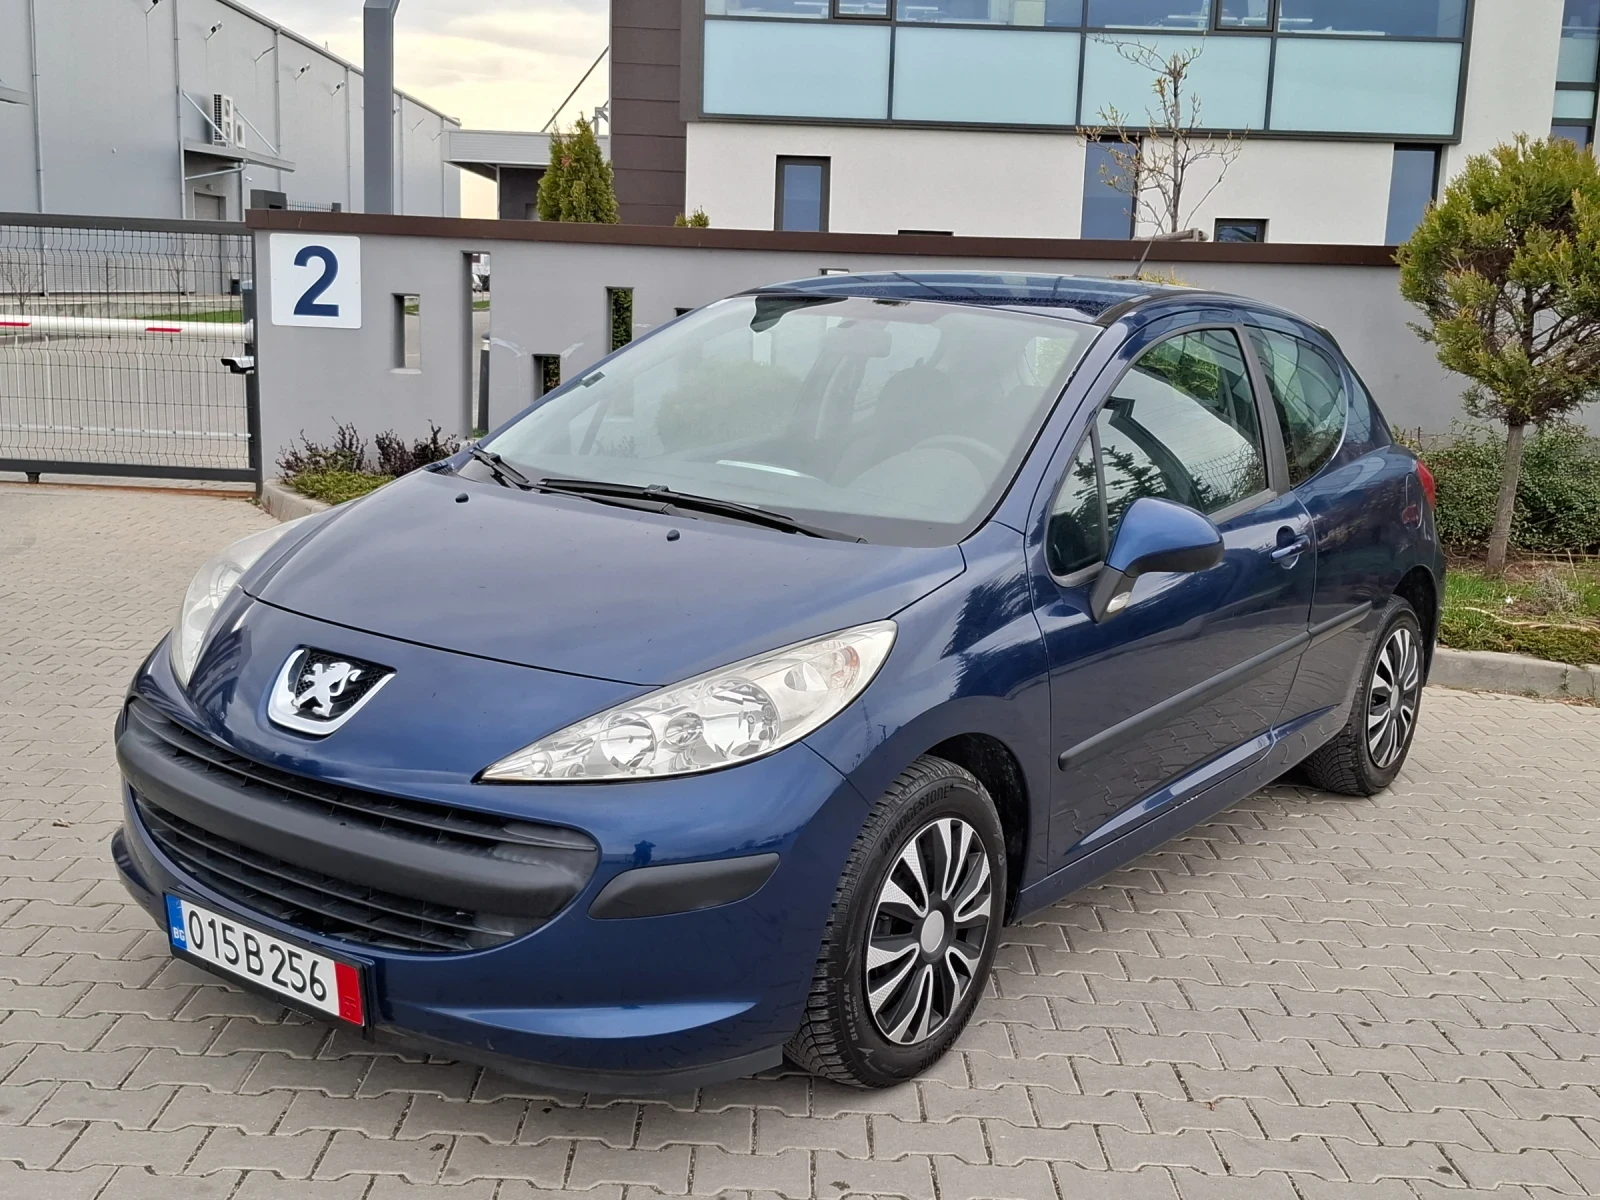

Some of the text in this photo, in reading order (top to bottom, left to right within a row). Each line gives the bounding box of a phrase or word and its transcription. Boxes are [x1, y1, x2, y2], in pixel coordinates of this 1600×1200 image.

[293, 245, 339, 317] 2
[880, 784, 951, 855] BRIDGESTONE
[172, 926, 186, 941] BG
